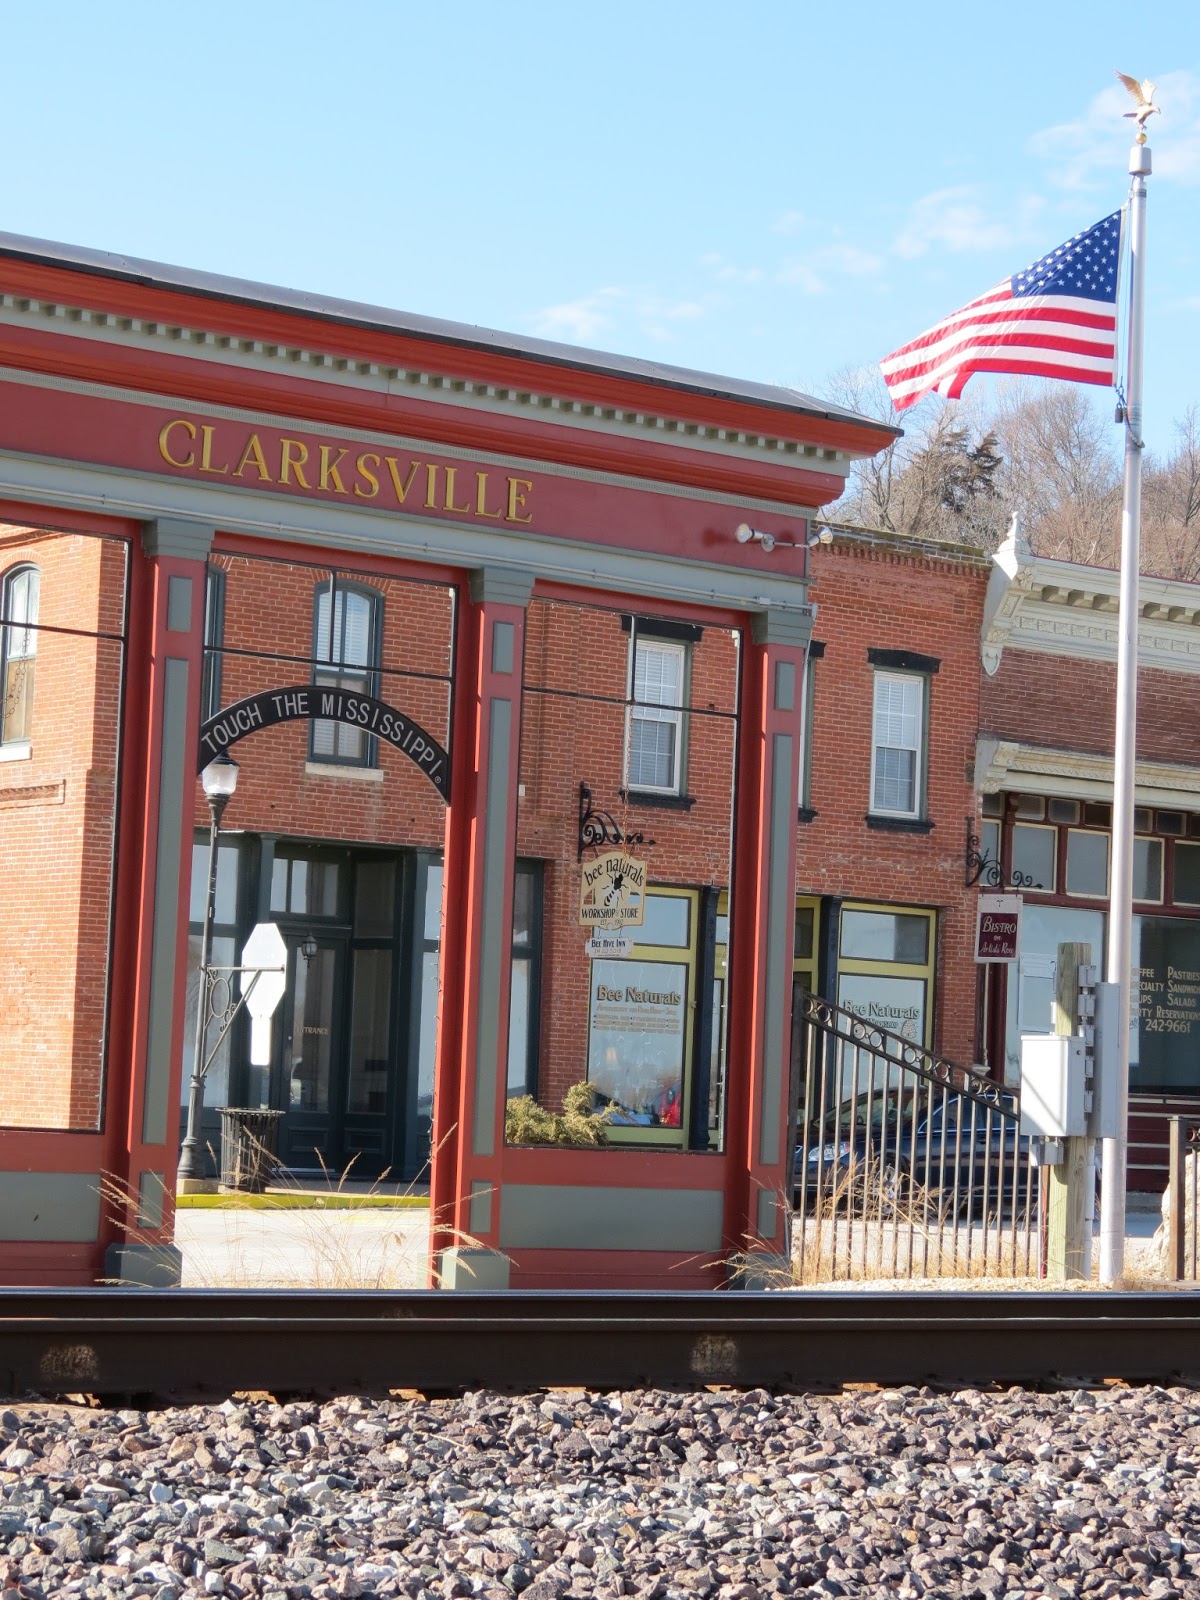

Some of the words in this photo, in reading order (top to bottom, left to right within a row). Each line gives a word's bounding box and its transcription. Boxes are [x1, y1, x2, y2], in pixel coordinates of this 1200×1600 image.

[158, 420, 533, 524] CLARKSVILLE
[201, 703, 263, 753] TOUCH
[272, 693, 310, 718] THE
[584, 863, 603, 887] bee
[606, 858, 645, 887] naturals
[581, 908, 615, 919] WORKSHOP
[620, 908, 639, 919] STORE
[982, 915, 1017, 935] BISTRO
[591, 939, 601, 948] BEE
[602, 939, 615, 948] HIVE
[616, 939, 626, 947] INN
[1167, 966, 1200, 981] PASTRIES
[597, 984, 623, 1001] Bee
[625, 986, 681, 1005] Naturals
[1167, 993, 1197, 1007] SALADS
[843, 999, 867, 1016] Bee
[868, 1000, 919, 1020] Naturals
[1145, 1019, 1190, 1033] 242-9661
